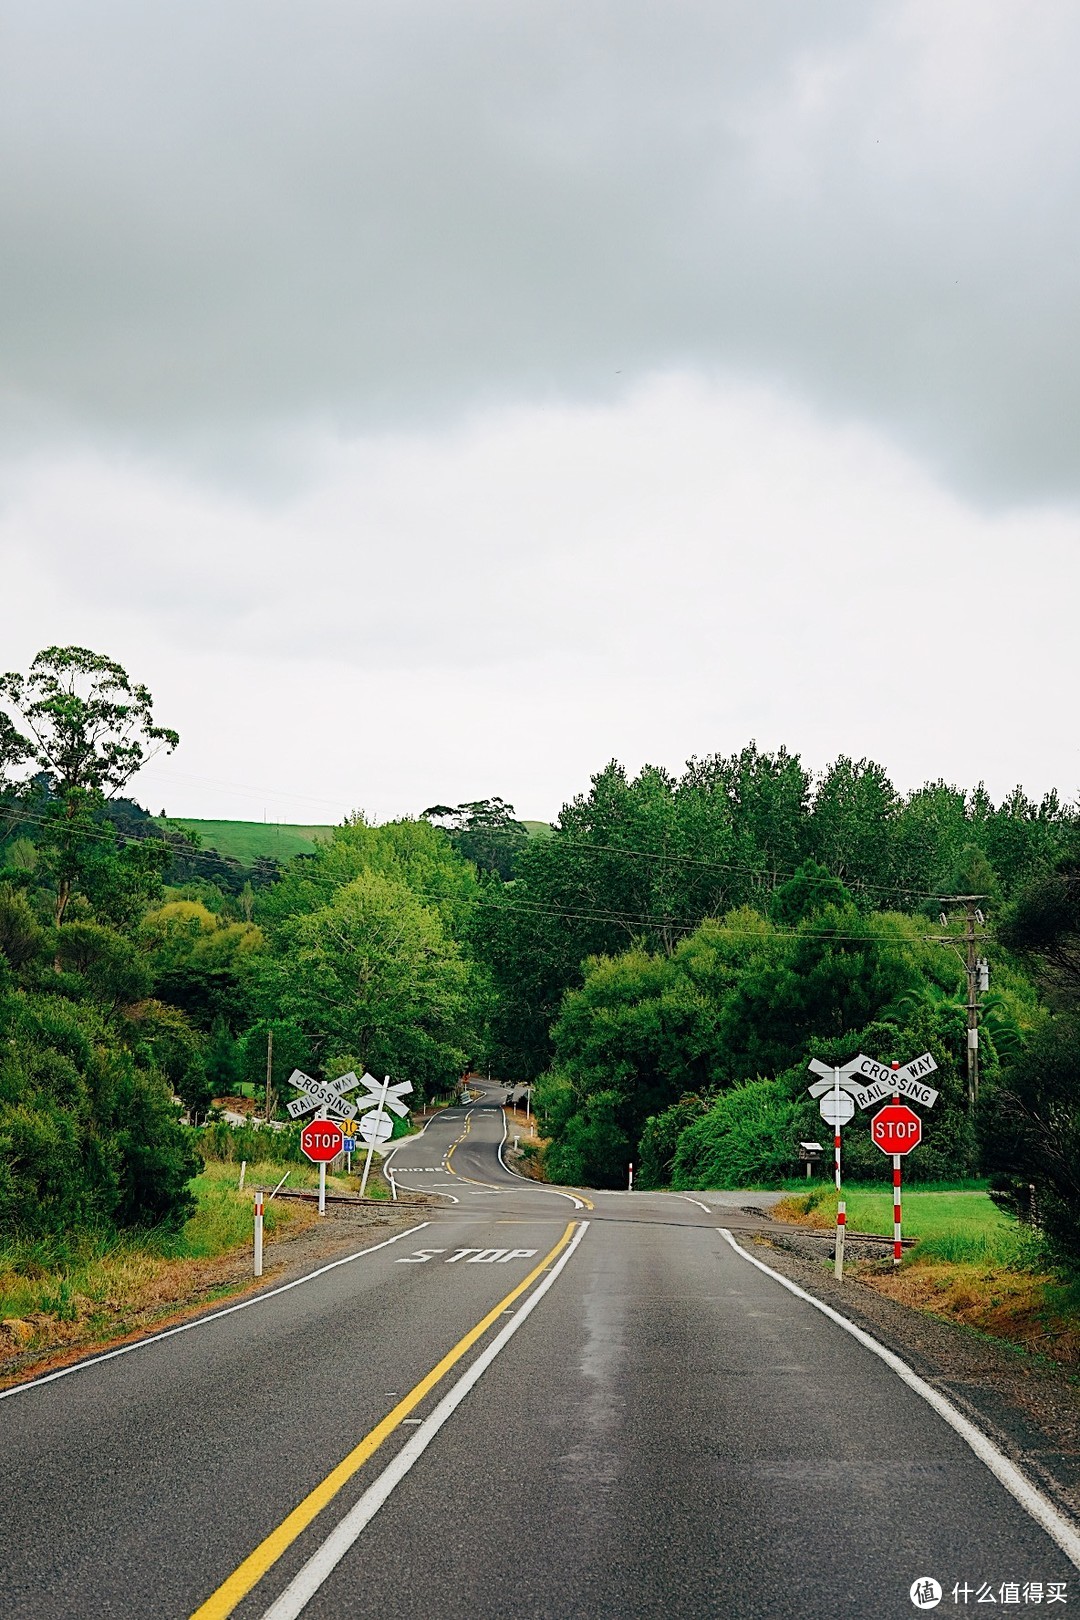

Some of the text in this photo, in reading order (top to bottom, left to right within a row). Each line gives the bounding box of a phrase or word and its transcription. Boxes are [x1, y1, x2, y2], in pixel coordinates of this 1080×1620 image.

[291, 1076, 353, 1115] RAIL WAY
[295, 1074, 351, 1116] CROSSING
[857, 1056, 932, 1106] RAIL WAY
[860, 1060, 931, 1102] CROSSING
[304, 1133, 341, 1149] STOP
[875, 1122, 917, 1138] STOP
[395, 1249, 538, 1263] STOP
